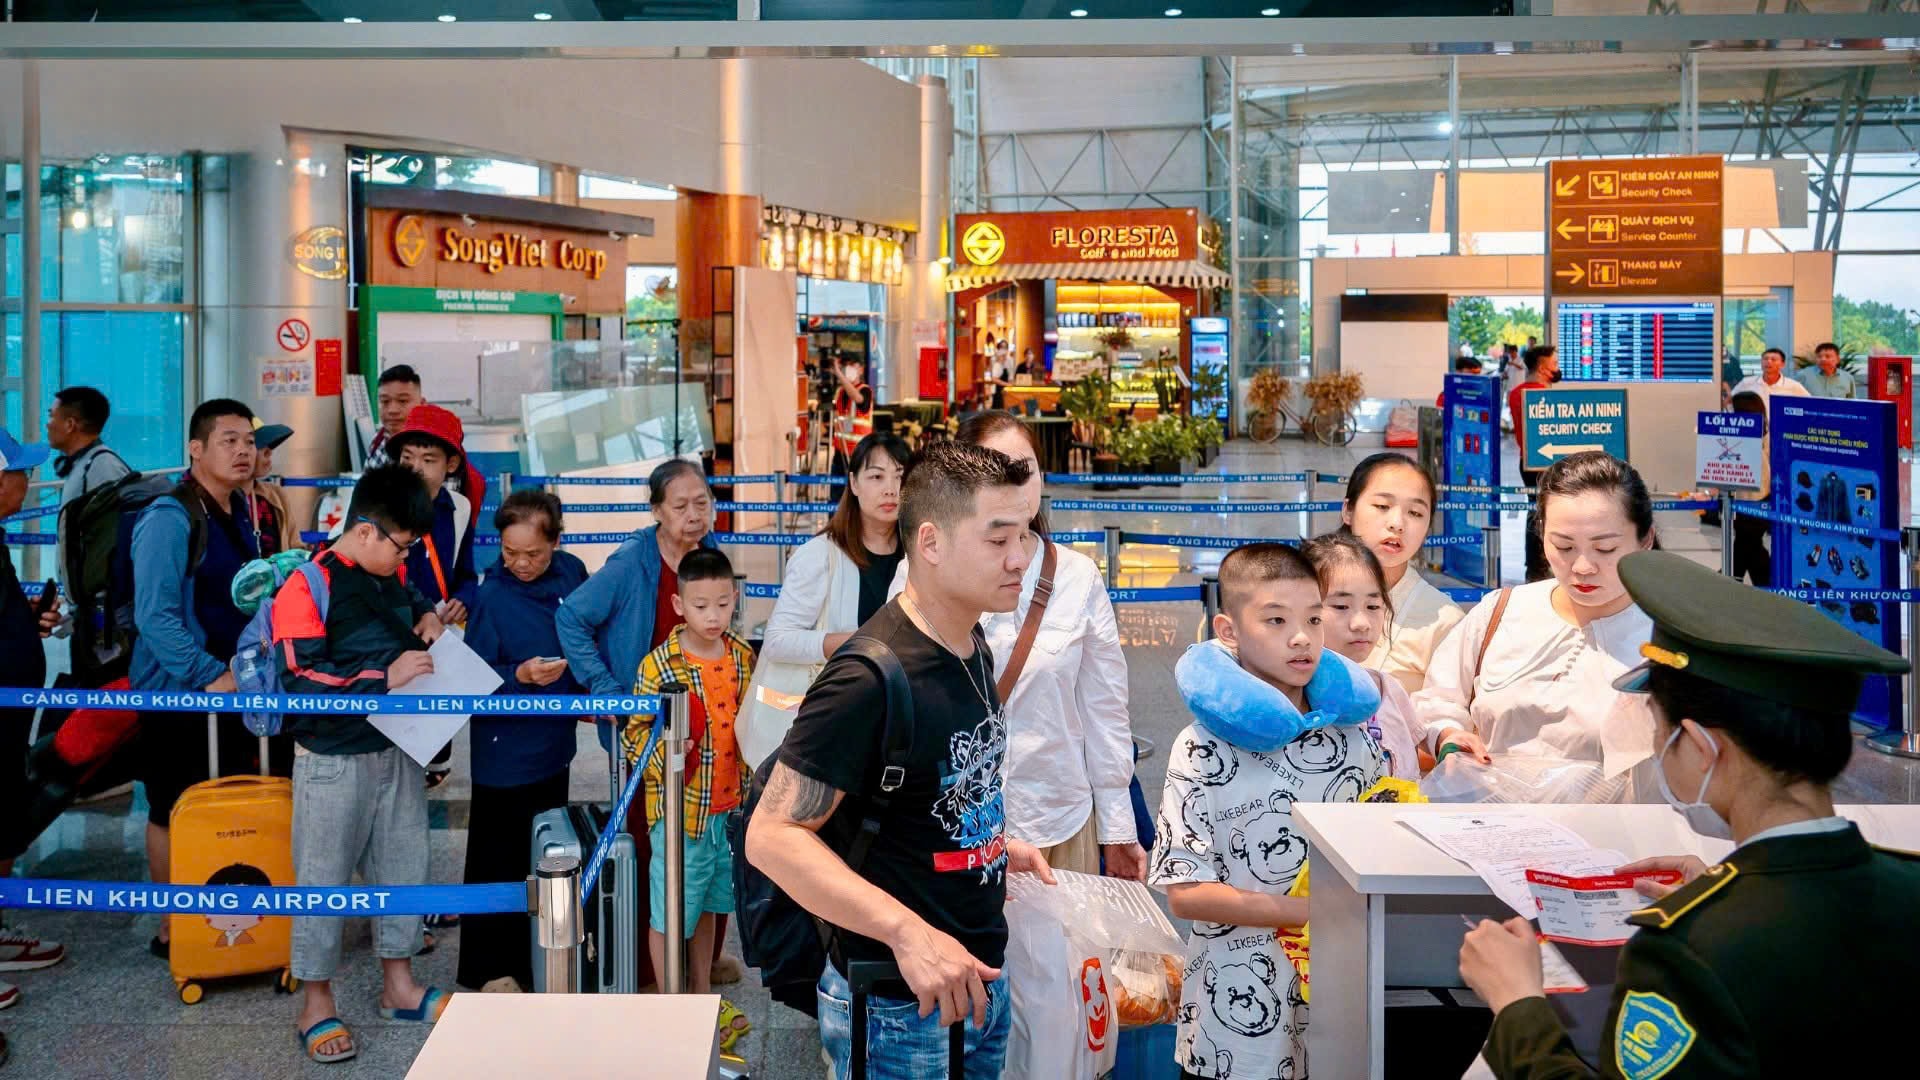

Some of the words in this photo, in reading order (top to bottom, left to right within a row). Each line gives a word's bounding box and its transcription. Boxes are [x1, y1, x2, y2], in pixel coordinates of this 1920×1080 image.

[1677, 172, 1692, 180] AN
[1693, 171, 1719, 180] NINH
[1621, 188, 1660, 198] Security
[1662, 188, 1692, 197] Check
[1652, 216, 1677, 227] DỊCH
[1679, 216, 1694, 227] VỤ
[1052, 225, 1178, 247] FLORESTA
[1621, 233, 1656, 242] Service
[1659, 232, 1697, 241] Counter
[295, 244, 334, 260] SONG
[445, 227, 548, 274] SongViet
[560, 240, 607, 280] Corp
[1621, 261, 1656, 270] THANG
[1621, 277, 1658, 286] Elevator
[1528, 396, 1555, 419] KIỂM
[1557, 404, 1575, 417] TRA
[1579, 403, 1595, 417] AN
[1597, 402, 1622, 417] NINH
[1538, 423, 1579, 436] SECURITY
[1581, 422, 1613, 434] CHECK
[1719, 427, 1740, 435] ENTRY
[566, 504, 610, 512] KHUONG
[747, 502, 783, 511] KHÔNG
[786, 502, 810, 511] LIÊN
[1082, 502, 1118, 511] KHÔNG
[1121, 502, 1145, 511] LIÊN
[1210, 504, 1233, 512] LIEN
[1283, 503, 1329, 511] AIRPORT
[1437, 502, 1466, 510] HÔNG
[1799, 518, 1832, 531] KHUONG
[1834, 521, 1870, 536] AIRPORT
[759, 534, 792, 544] HÀNG
[1205, 539, 1239, 548] HÀNG
[1814, 588, 1845, 599] LIÊN
[1850, 590, 1912, 600] KHƯƠNG
[22, 692, 79, 705] CẢNG
[87, 692, 144, 706] HÀNG
[152, 693, 226, 708] KHÔNG
[233, 694, 279, 709] LIÊN
[287, 697, 379, 711] KHƯƠNG
[418, 699, 464, 711] LIEN
[473, 699, 562, 711] KHUONG
[570, 699, 660, 711] AIRPORT
[1214, 799, 1265, 822] LIKEBEAR
[27, 887, 93, 906] LIEN
[108, 890, 239, 910] KHUONG
[252, 891, 391, 911] AIRPORT
